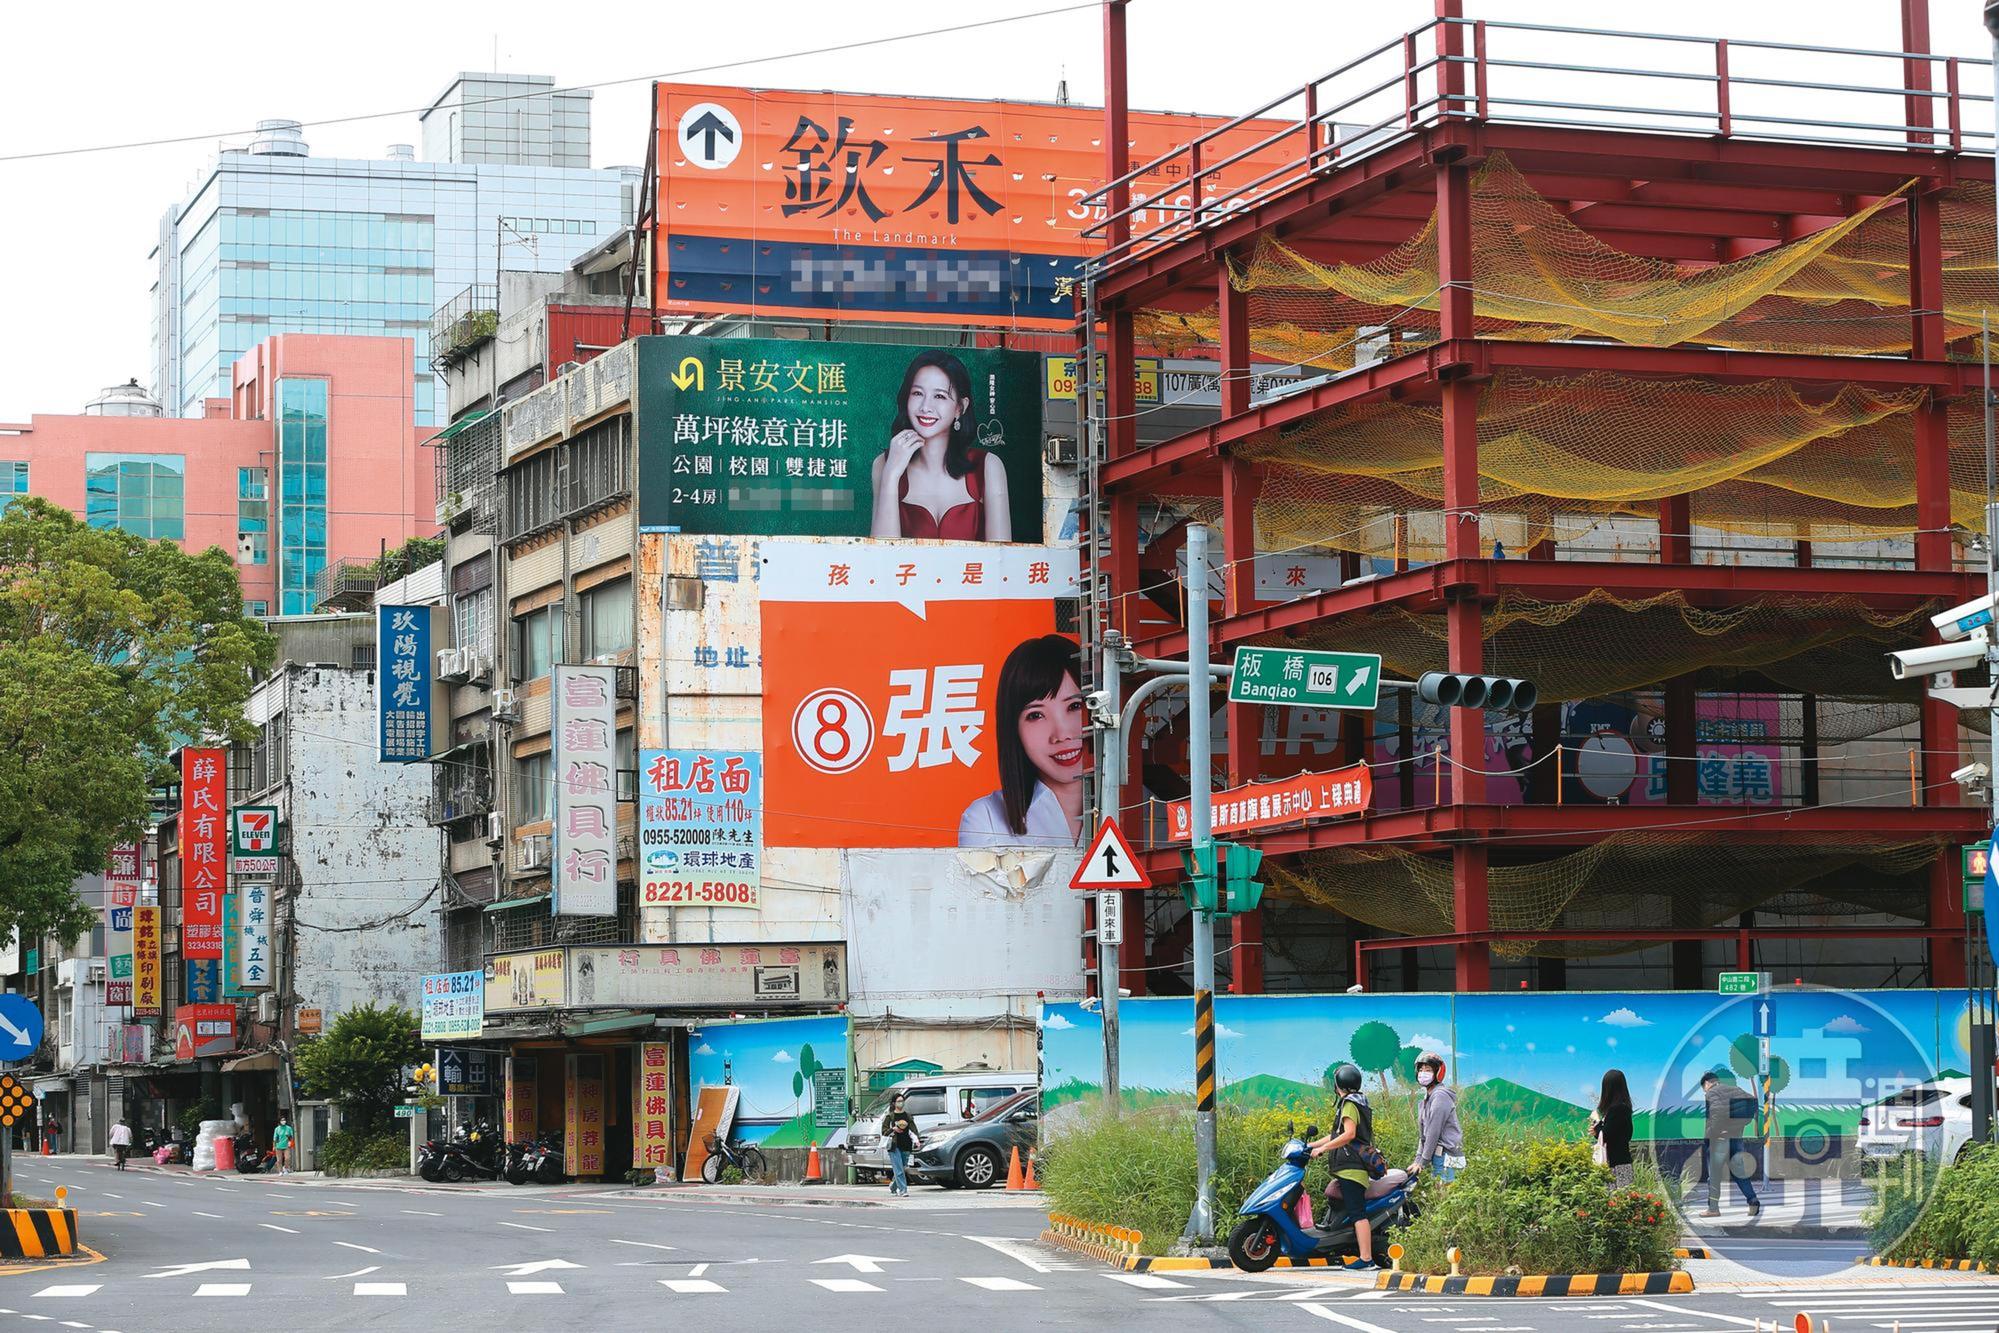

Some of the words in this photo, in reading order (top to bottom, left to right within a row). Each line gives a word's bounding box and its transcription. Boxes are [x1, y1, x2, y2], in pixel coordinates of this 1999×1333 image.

[779, 115, 1006, 225] 欽禾
[833, 228, 862, 242] The
[874, 230, 958, 246] Landmark
[716, 358, 848, 395] 景安文匯
[672, 413, 849, 449] 萬坪綠意首排
[672, 454, 713, 476] 公園
[728, 455, 769, 476] 校園
[785, 456, 848, 478] 雙捷運
[672, 487, 717, 505] 2-4房
[391, 610, 421, 707] 玖陽視覺
[1240, 653, 1305, 681] 板橋
[1240, 681, 1298, 700] Banqiao
[1312, 671, 1334, 687] 106
[882, 664, 985, 773] 張
[565, 674, 611, 886] 富蓮佛具行
[647, 754, 751, 794] 租店面
[191, 757, 219, 917] 薛氏有限公司
[643, 828, 711, 845] 0955-520008
[712, 828, 754, 843] 陳先生
[235, 858, 277, 872] 前方50公尺
[682, 850, 755, 870] 環球地產
[645, 881, 750, 904] 8221-5808
[1103, 893, 1116, 941] 右側來車
[140, 962, 154, 1005] 印刷廠
[645, 1047, 667, 1164] 富蓮佛具行
